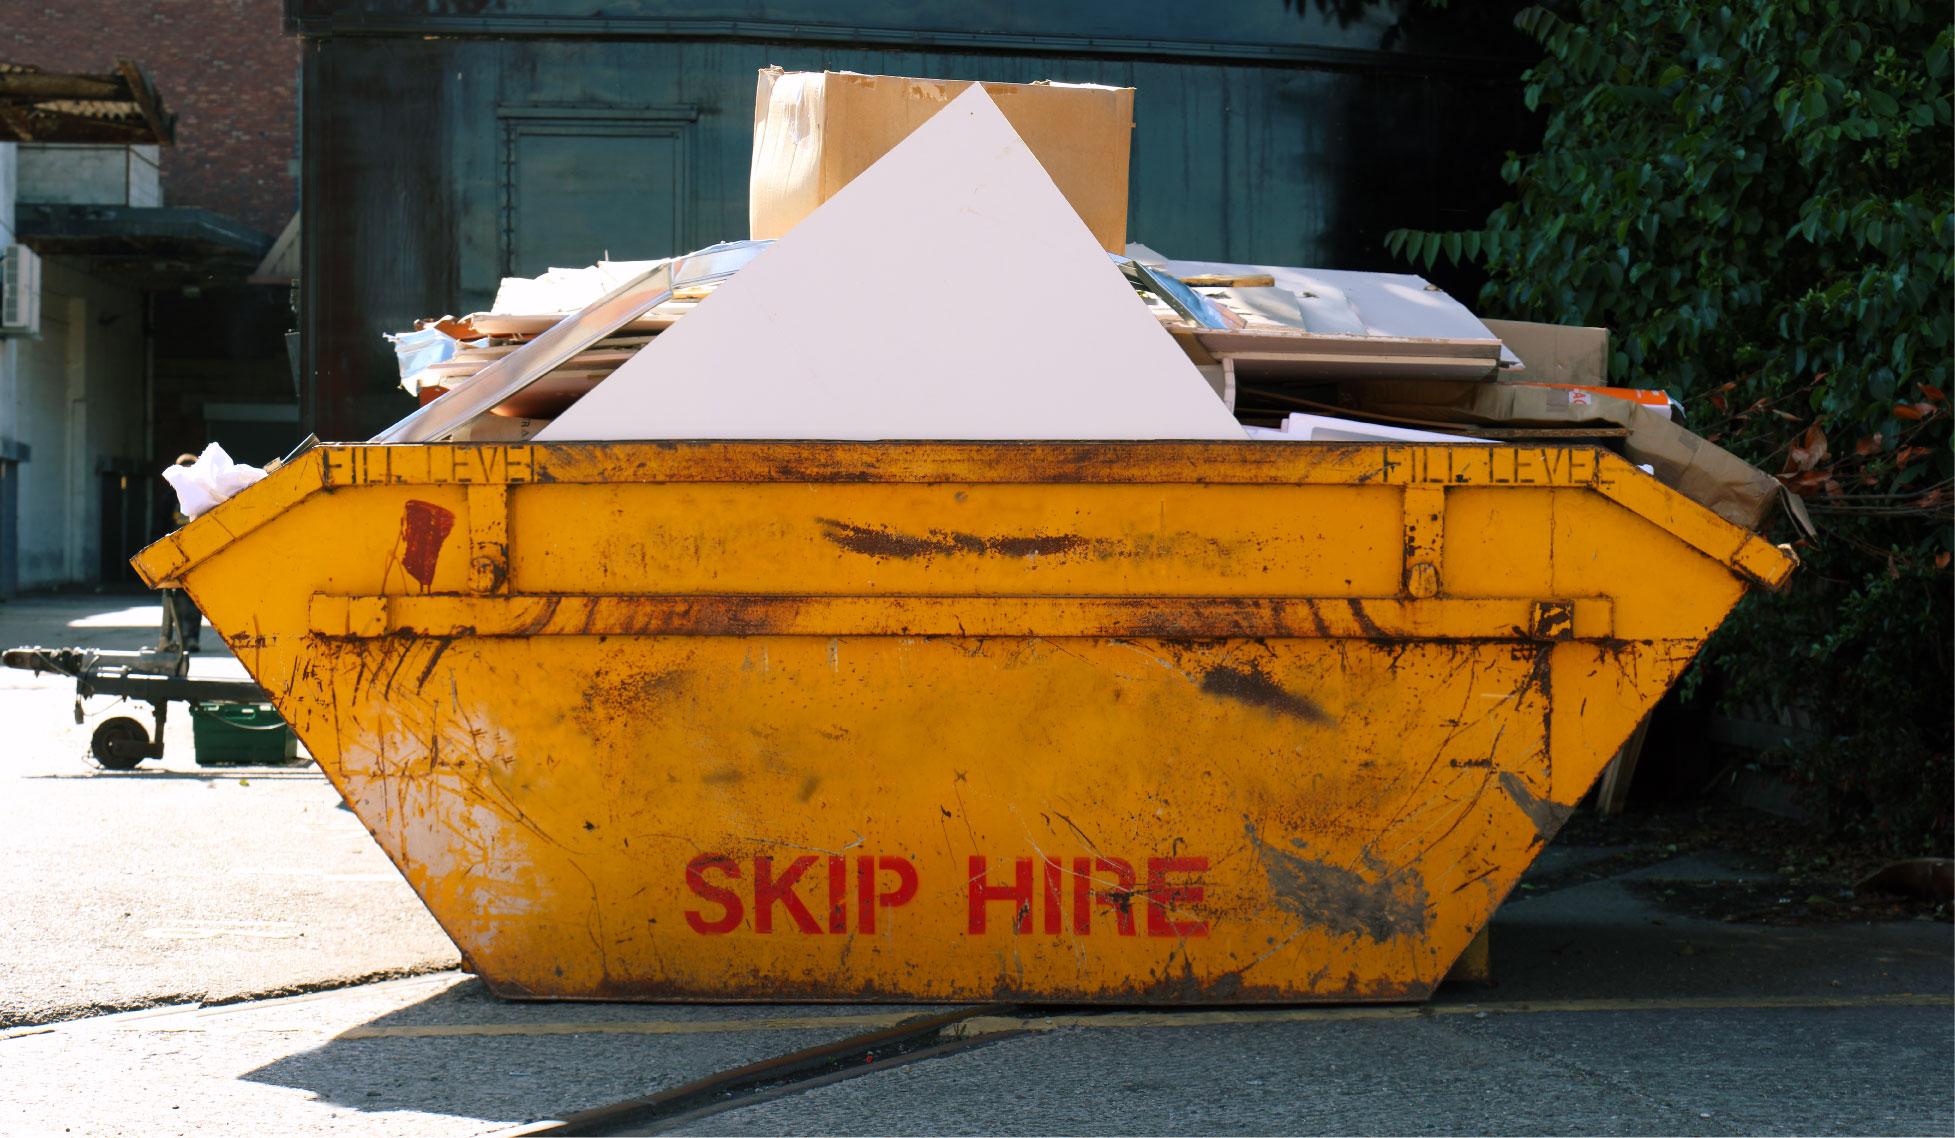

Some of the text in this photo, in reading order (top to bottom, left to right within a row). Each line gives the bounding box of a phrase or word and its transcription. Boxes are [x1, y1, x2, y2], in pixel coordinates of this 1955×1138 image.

[323, 446, 545, 484] FILL LEVEL
[1383, 447, 1616, 484] FILL LEVEL
[684, 853, 1210, 937] SKIP HIRE
